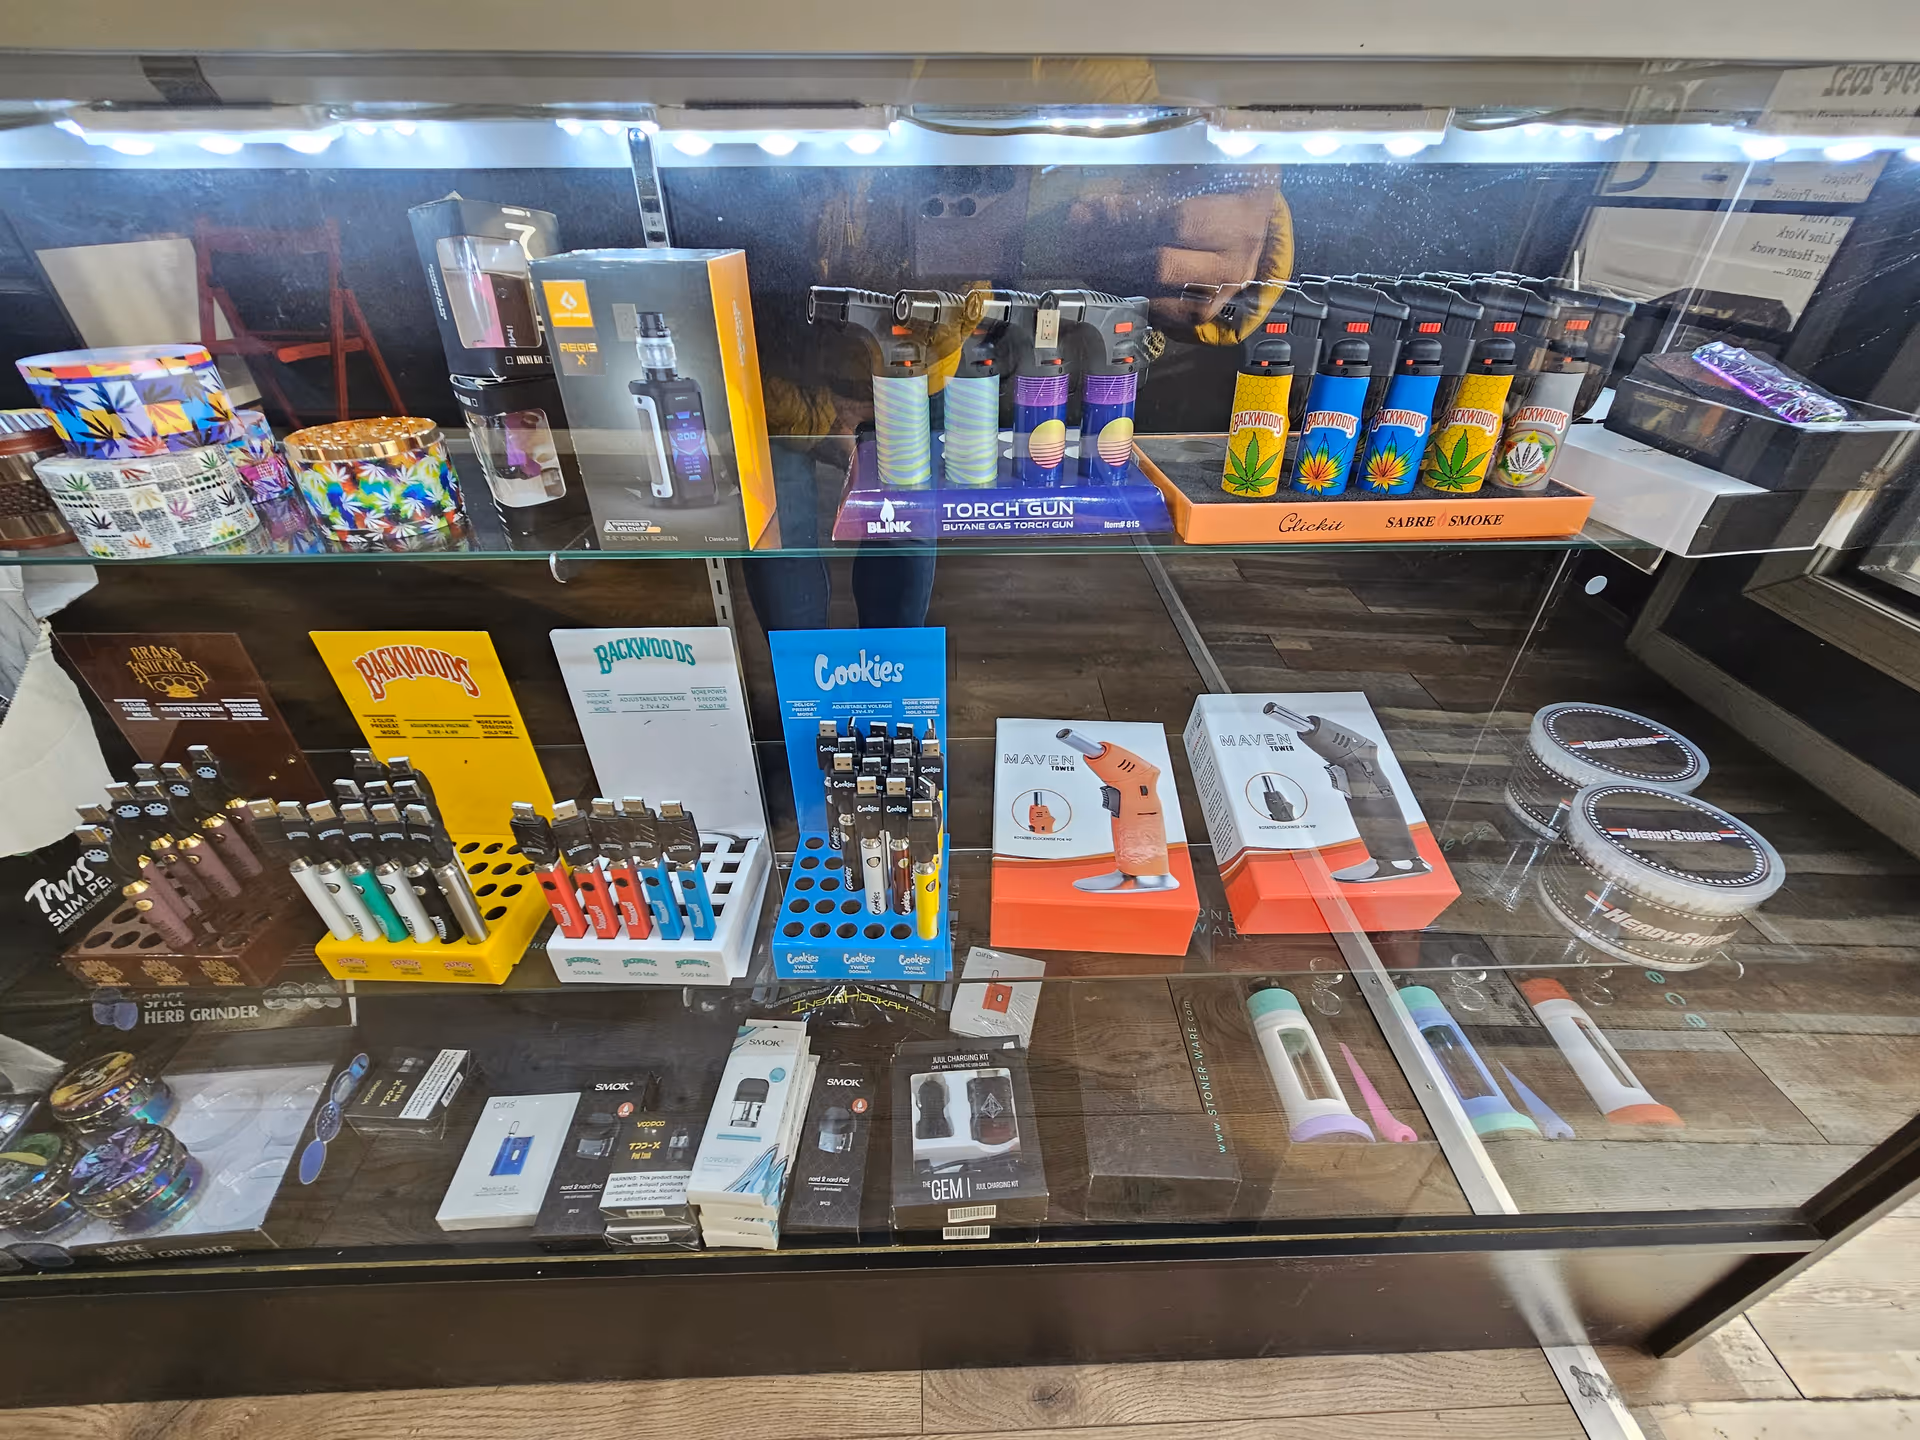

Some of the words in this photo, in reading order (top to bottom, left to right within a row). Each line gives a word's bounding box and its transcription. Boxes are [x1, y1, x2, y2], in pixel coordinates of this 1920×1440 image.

[559, 343, 598, 353] AEGIS
[576, 354, 587, 366] X
[1232, 410, 1284, 436] BACKWOODS
[1304, 410, 1360, 437] BACKWOODS
[1372, 409, 1430, 435] BACKWOODS
[1442, 410, 1499, 437] BACKWOODS
[1510, 406, 1571, 435] BACKWOODS
[942, 502, 1021, 518] TORCH
[1026, 500, 1074, 517] GUN
[867, 521, 912, 533] BLINK
[942, 521, 985, 531] BUTANE
[988, 521, 1012, 530] GAS
[1013, 520, 1049, 530] TORCH
[1051, 519, 1074, 529] GUN
[1125, 520, 1140, 529] 815
[1385, 515, 1436, 529] SABRE
[1448, 513, 1505, 528] SMOKE
[130, 645, 183, 661] BRASS
[593, 637, 696, 674] BACKWOODS
[126, 660, 208, 686] KNUCKLES
[352, 644, 481, 702] BACKWOODS
[814, 649, 905, 691] Cookies
[1219, 733, 1292, 747] MAVEN
[1003, 753, 1075, 766] MAVEN
[857, 805, 879, 814] Cookies
[886, 805, 907, 814] Cookies
[24, 856, 95, 914] TWIS
[48, 893, 88, 926] SLIM
[787, 952, 819, 964] Cookies
[843, 953, 875, 965] Cookies
[899, 954, 930, 966] Cookies
[144, 1009, 185, 1024] HERB
[190, 1005, 259, 1022] GRINDER
[749, 1038, 780, 1047] SMOK
[932, 1056, 946, 1064] JUUL
[948, 1054, 978, 1063] CHARGING
[979, 1053, 989, 1061] KIT
[595, 1082, 630, 1091] SMOK
[827, 1078, 860, 1087] SMOK
[931, 1178, 963, 1200] GEM
[987, 1181, 1010, 1189] CHARGING
[96, 1244, 146, 1256] SPICE
